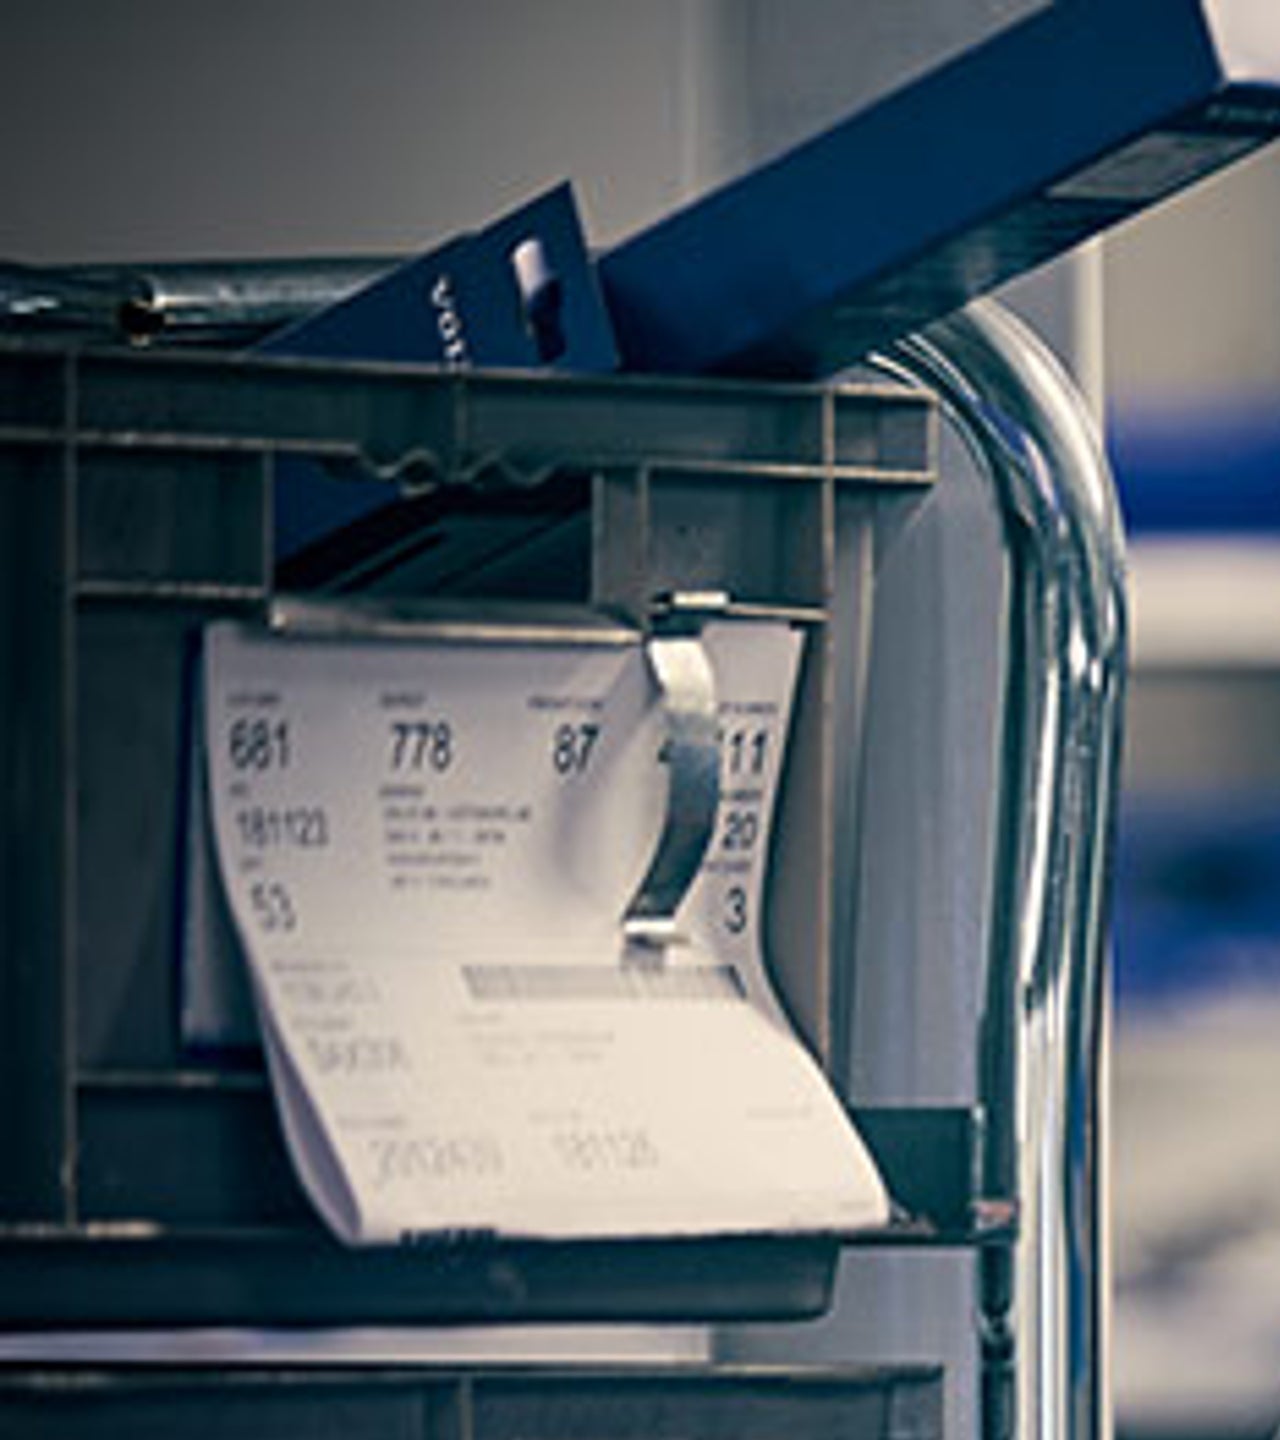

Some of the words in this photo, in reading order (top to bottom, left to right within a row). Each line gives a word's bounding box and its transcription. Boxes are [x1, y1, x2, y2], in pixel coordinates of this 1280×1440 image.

[229, 721, 290, 772] 681
[390, 722, 452, 772] 778
[552, 723, 599, 775] 87
[722, 812, 758, 851] 20
[723, 888, 748, 933] 3
